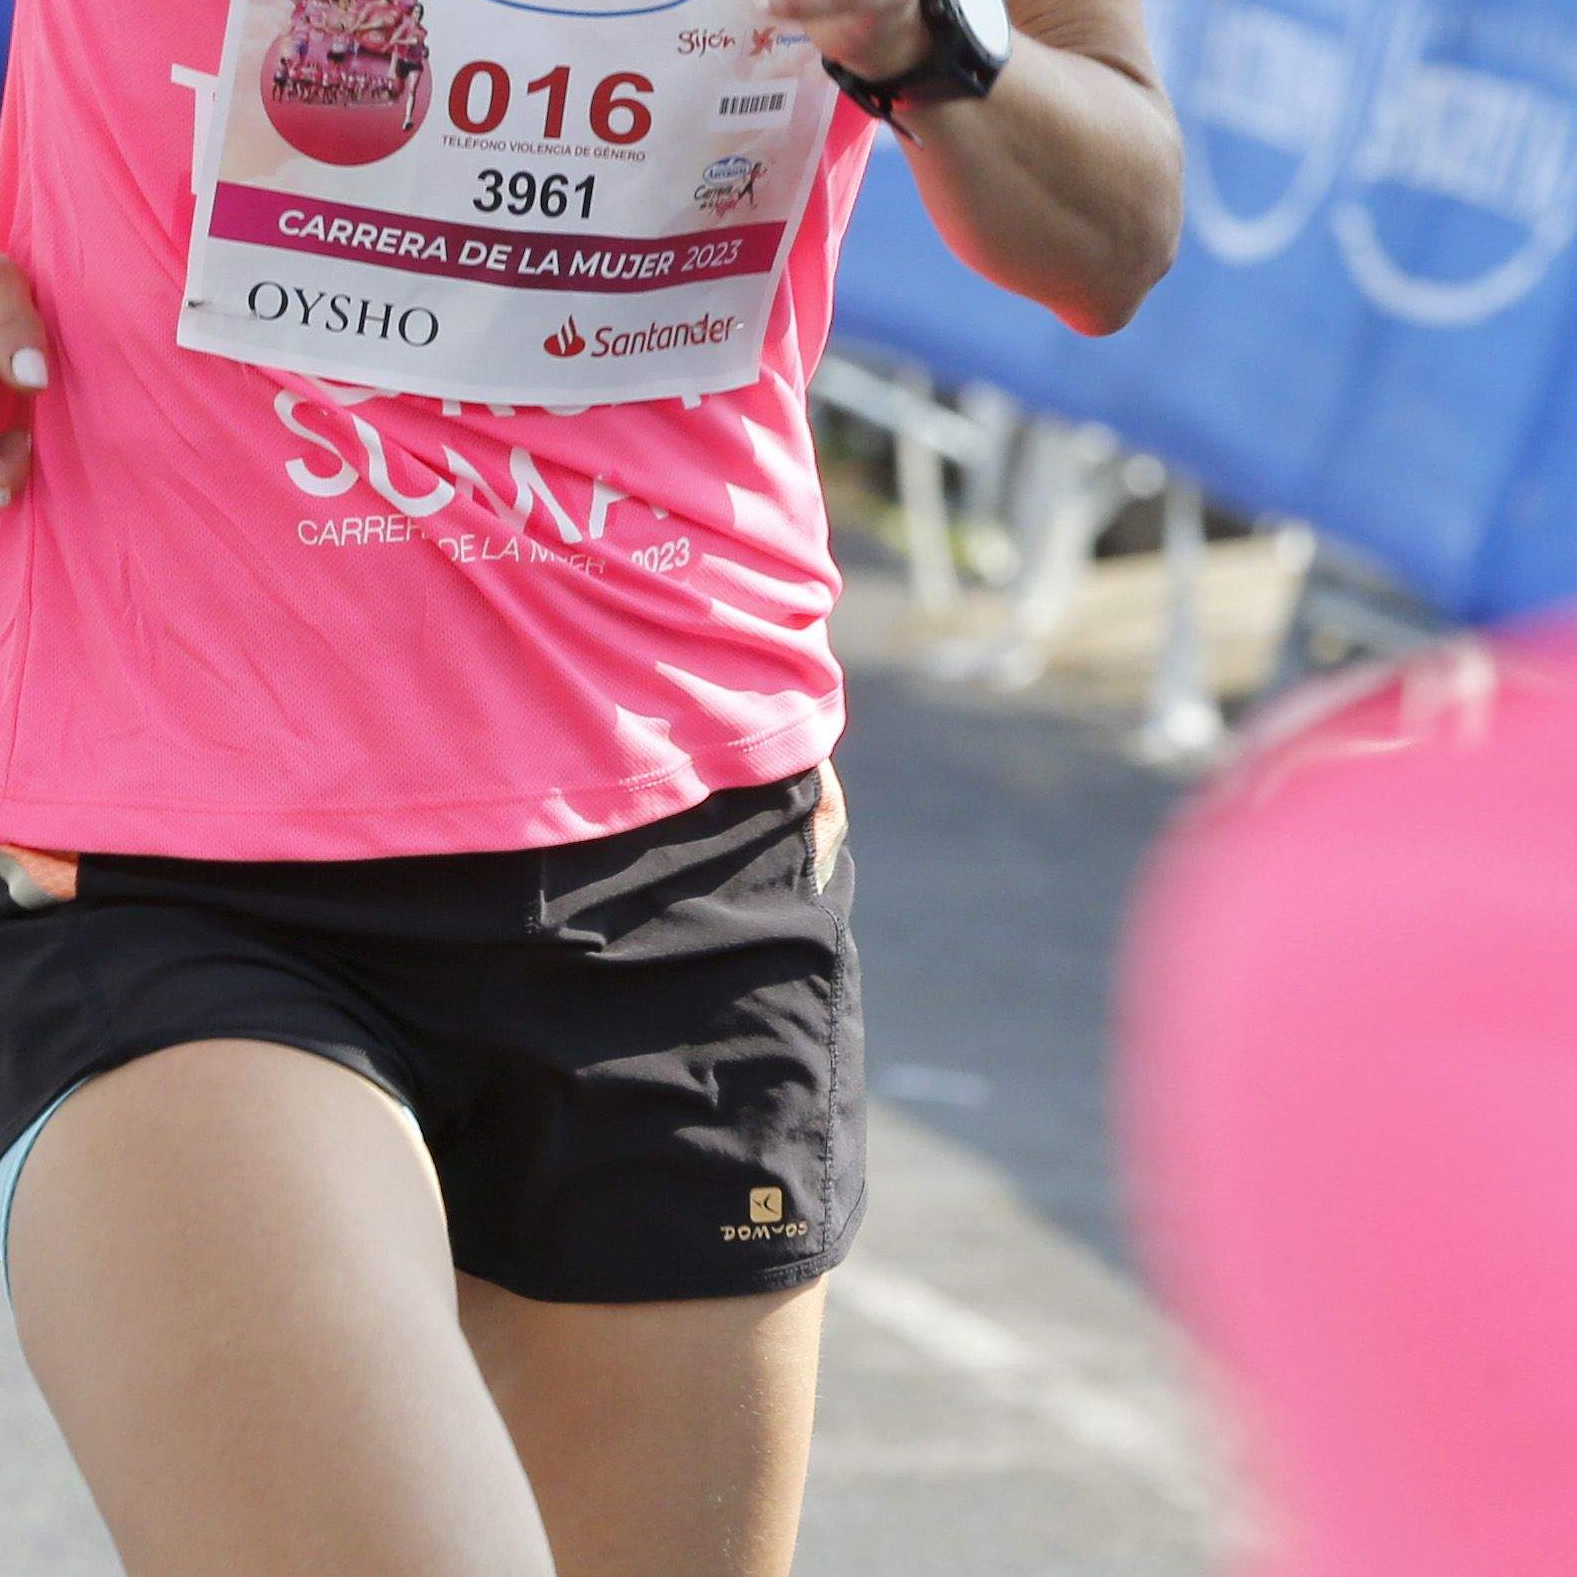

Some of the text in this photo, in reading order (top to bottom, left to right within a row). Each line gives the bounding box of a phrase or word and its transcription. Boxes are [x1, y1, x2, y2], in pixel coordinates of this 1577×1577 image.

[448, 60, 655, 145] 016
[442, 134, 646, 163] TELÉFONO VIOLENCIA DE GÉNERO
[473, 169, 596, 220] 3961
[278, 208, 744, 281] CARRERA DE LA MUJER 2023
[247, 280, 440, 348] OYSHO
[591, 314, 735, 359] Santander
[482, 536, 520, 562] LA
